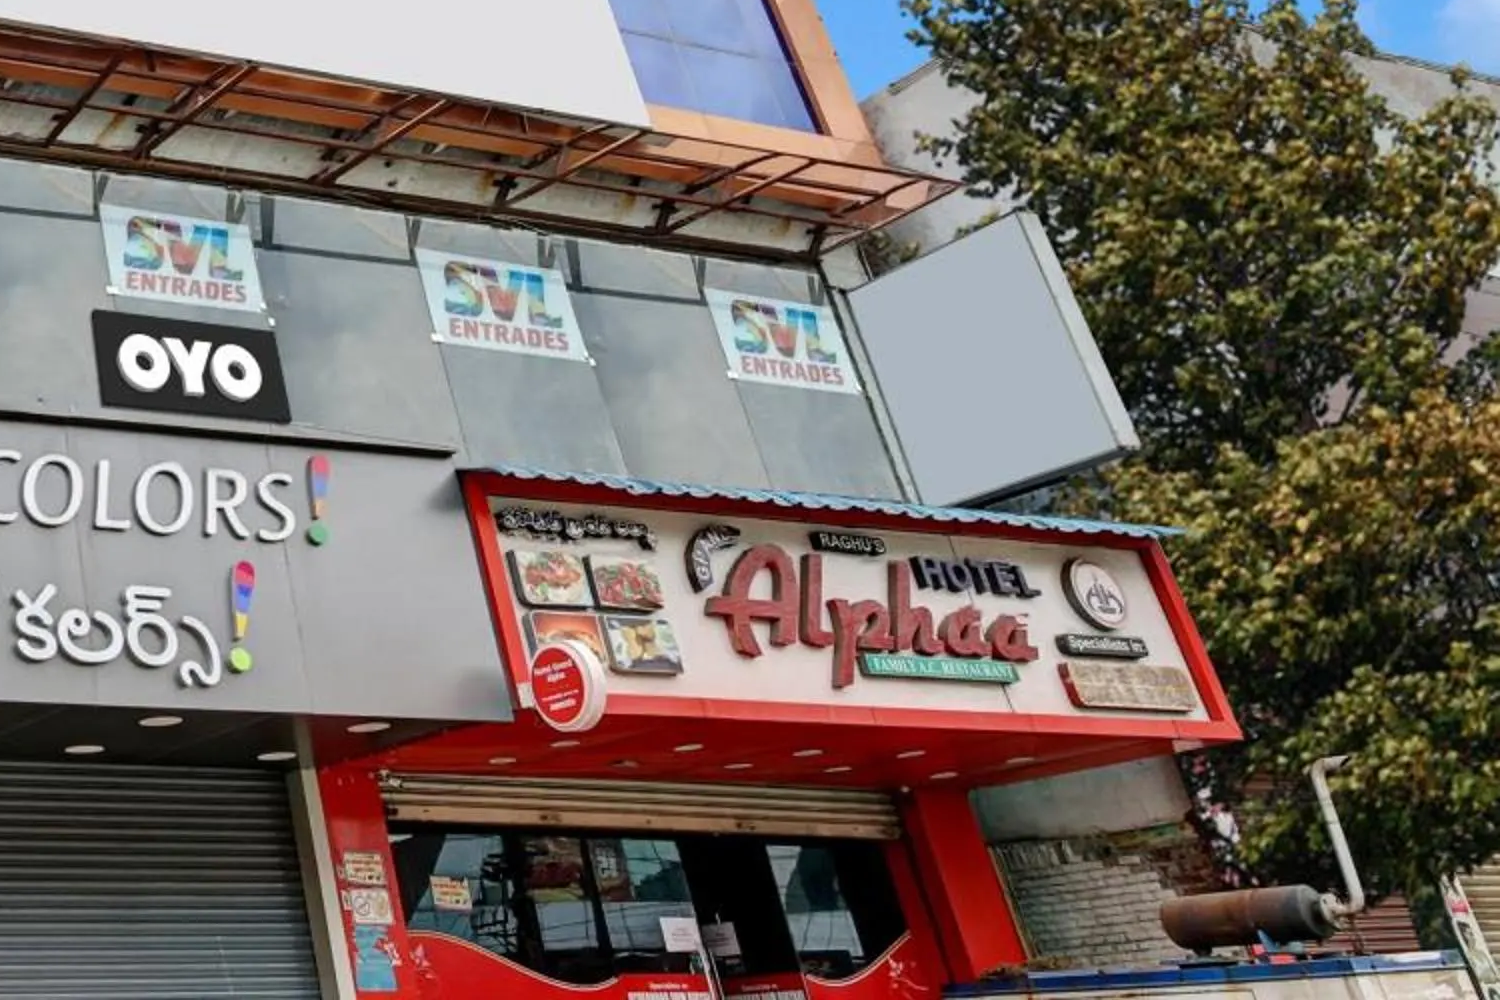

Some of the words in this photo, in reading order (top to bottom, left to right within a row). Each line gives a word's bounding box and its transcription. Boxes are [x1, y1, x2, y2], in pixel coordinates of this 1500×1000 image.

[123, 215, 243, 281] SVL
[125, 271, 247, 303] ENTRADES
[444, 260, 563, 328] SVL
[450, 317, 569, 351] ENTRADES
[731, 299, 837, 364] SVL
[116, 333, 263, 402] OYO
[740, 355, 844, 386] ENTRADES
[818, 532, 887, 554] RAGHU'S
[910, 555, 1042, 599] HOTEL
